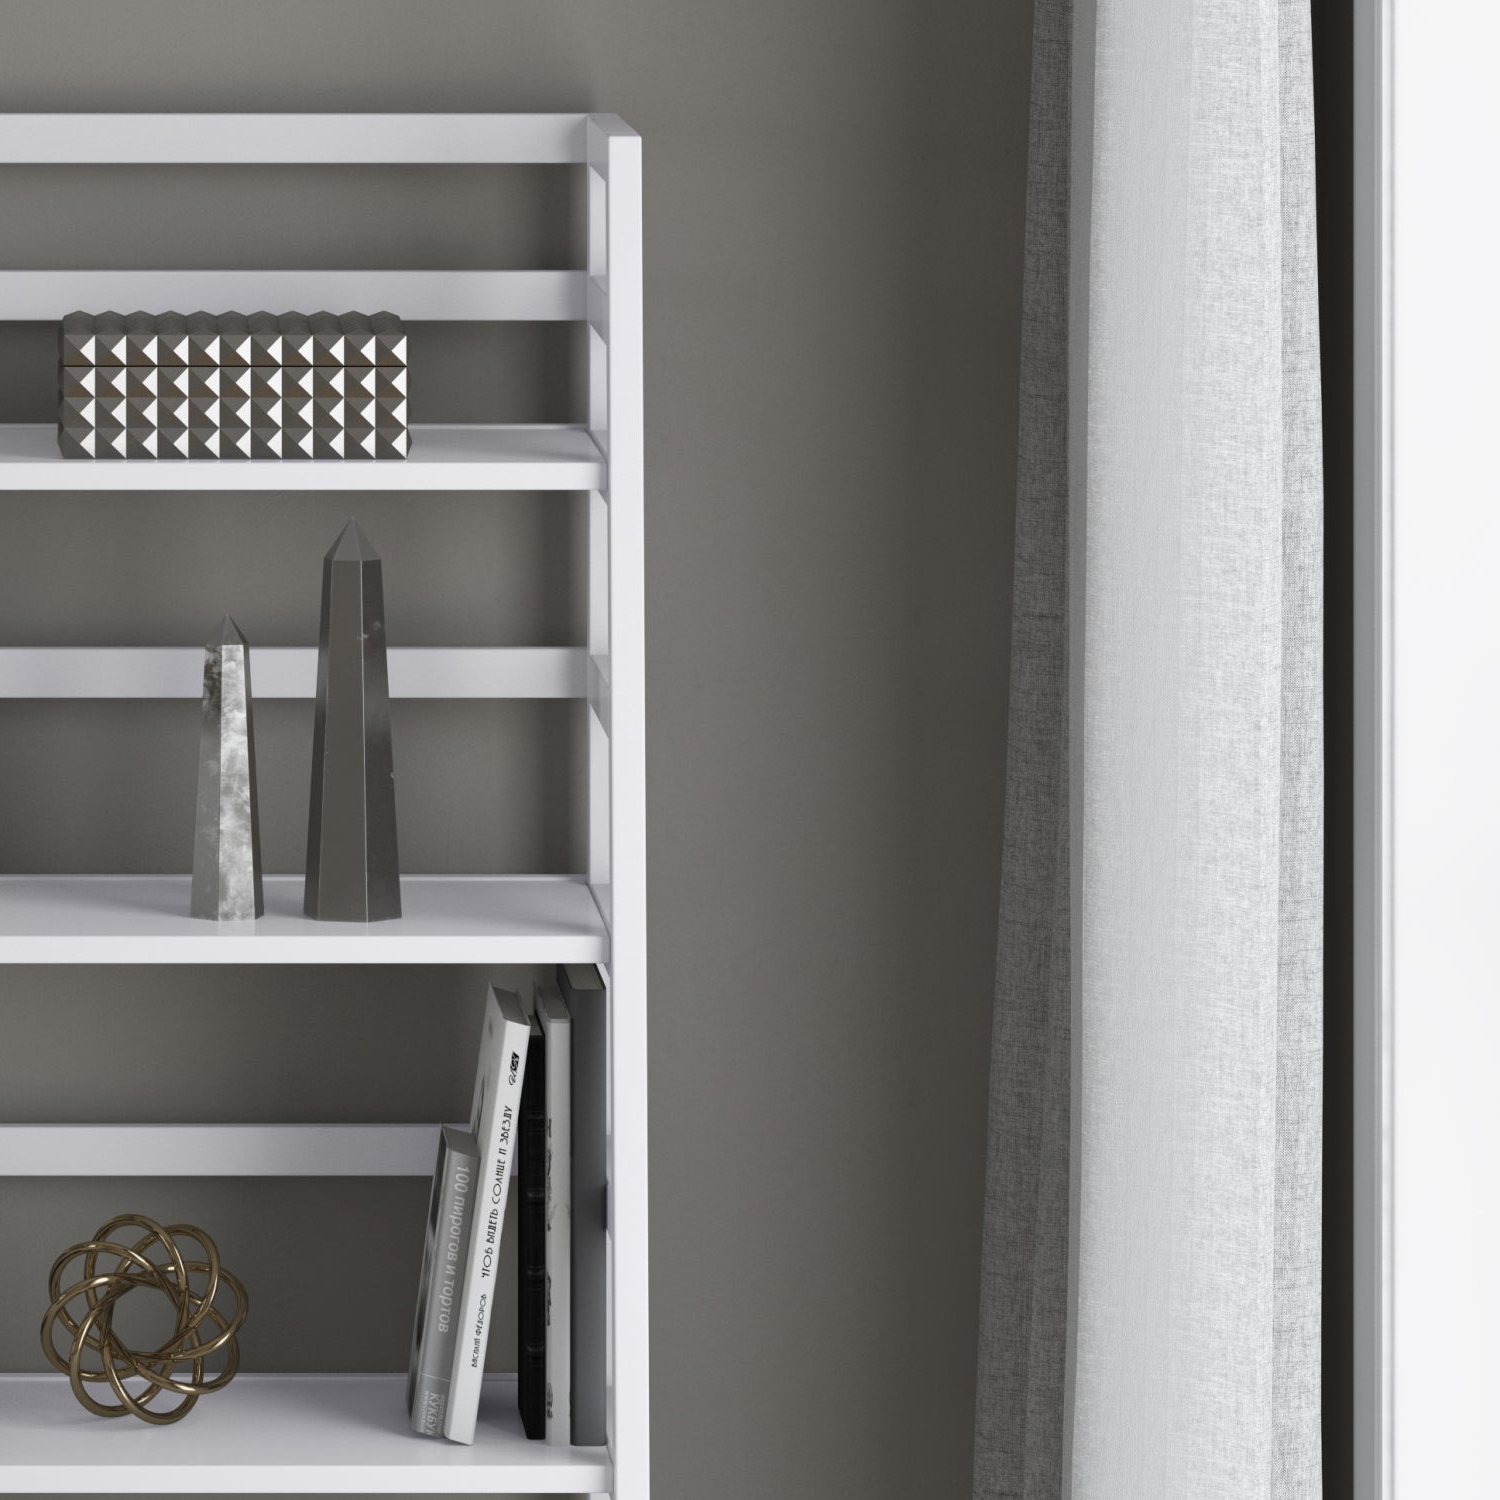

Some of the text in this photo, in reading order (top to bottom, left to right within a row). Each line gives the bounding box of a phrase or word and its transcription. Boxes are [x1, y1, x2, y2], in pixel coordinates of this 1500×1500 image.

[454, 1165, 470, 1193] 100
[447, 1196, 466, 1262] пирогов
[438, 1278, 455, 1333] тортов
